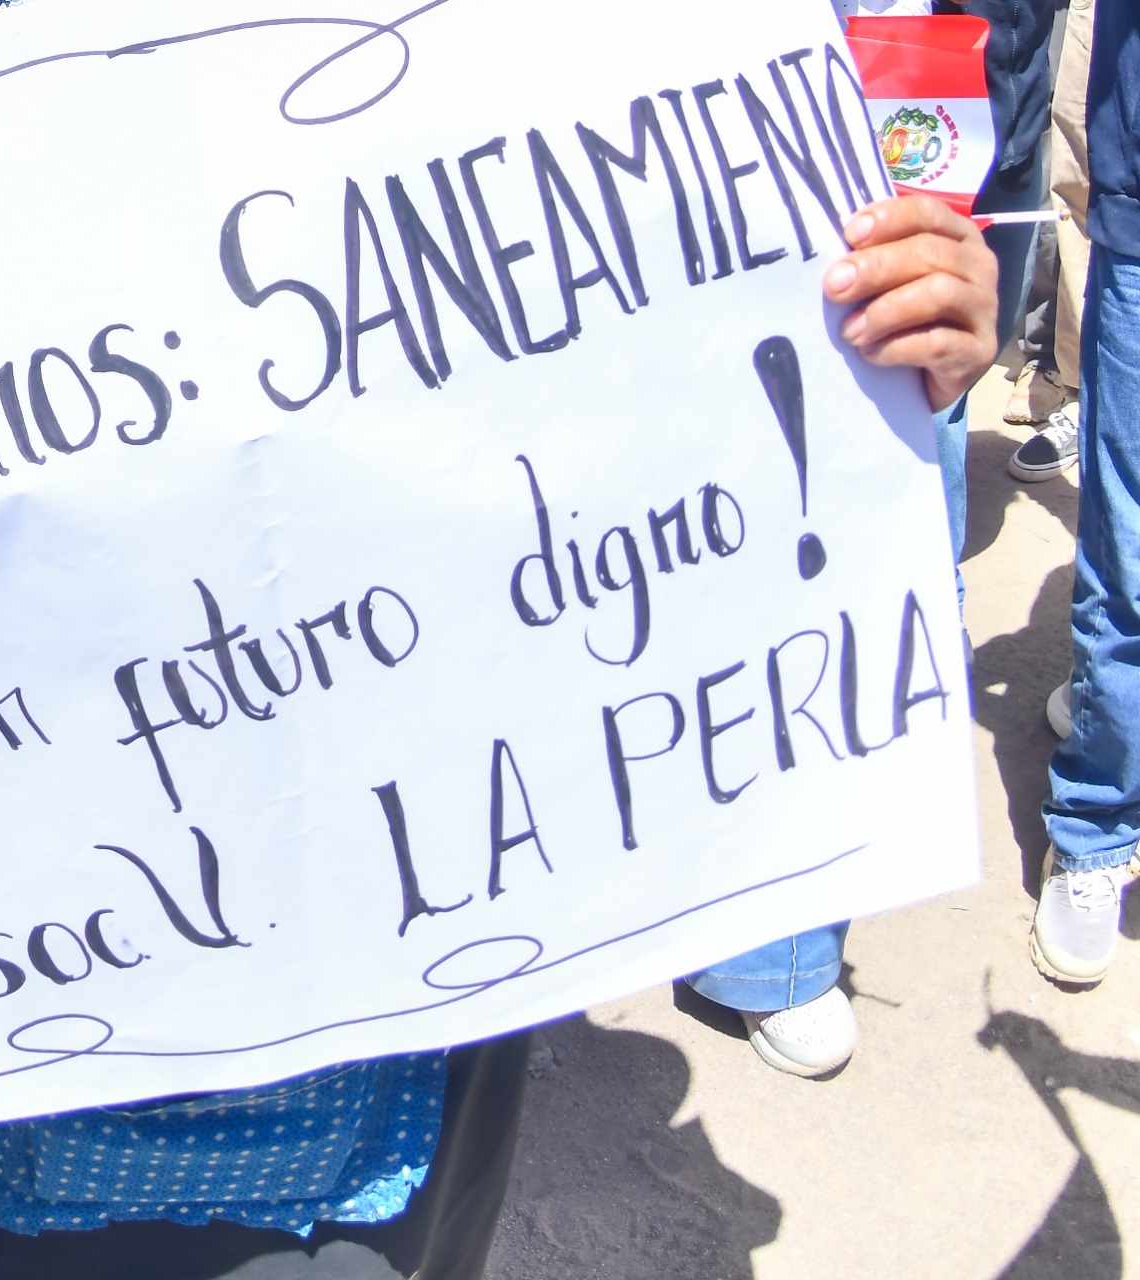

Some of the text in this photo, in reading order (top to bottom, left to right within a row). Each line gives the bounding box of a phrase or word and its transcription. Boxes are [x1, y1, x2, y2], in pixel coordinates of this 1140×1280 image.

[220, 42, 897, 412] SANEAMIENTO
[113, 578, 419, 813] futuro
[371, 737, 553, 938] LA
[602, 589, 951, 852] PERLA
